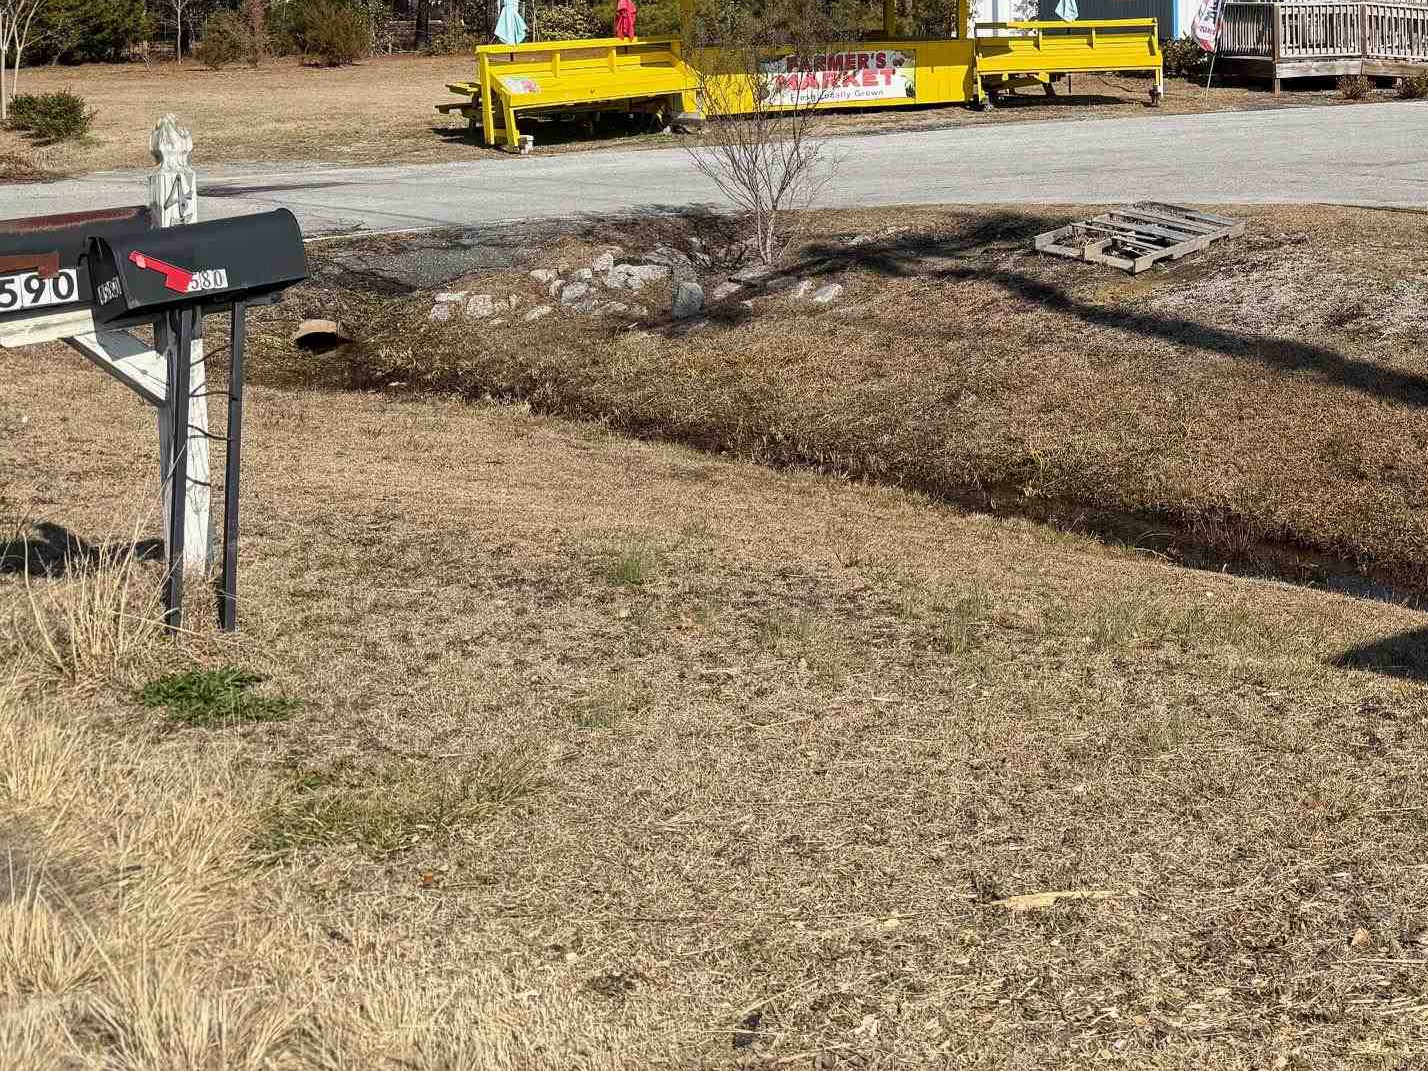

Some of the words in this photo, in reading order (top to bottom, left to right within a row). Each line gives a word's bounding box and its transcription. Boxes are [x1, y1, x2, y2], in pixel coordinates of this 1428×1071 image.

[786, 52, 887, 73] FARMER'S
[774, 68, 896, 90] MARKET
[0, 271, 75, 308] 590
[191, 269, 224, 290] 580
